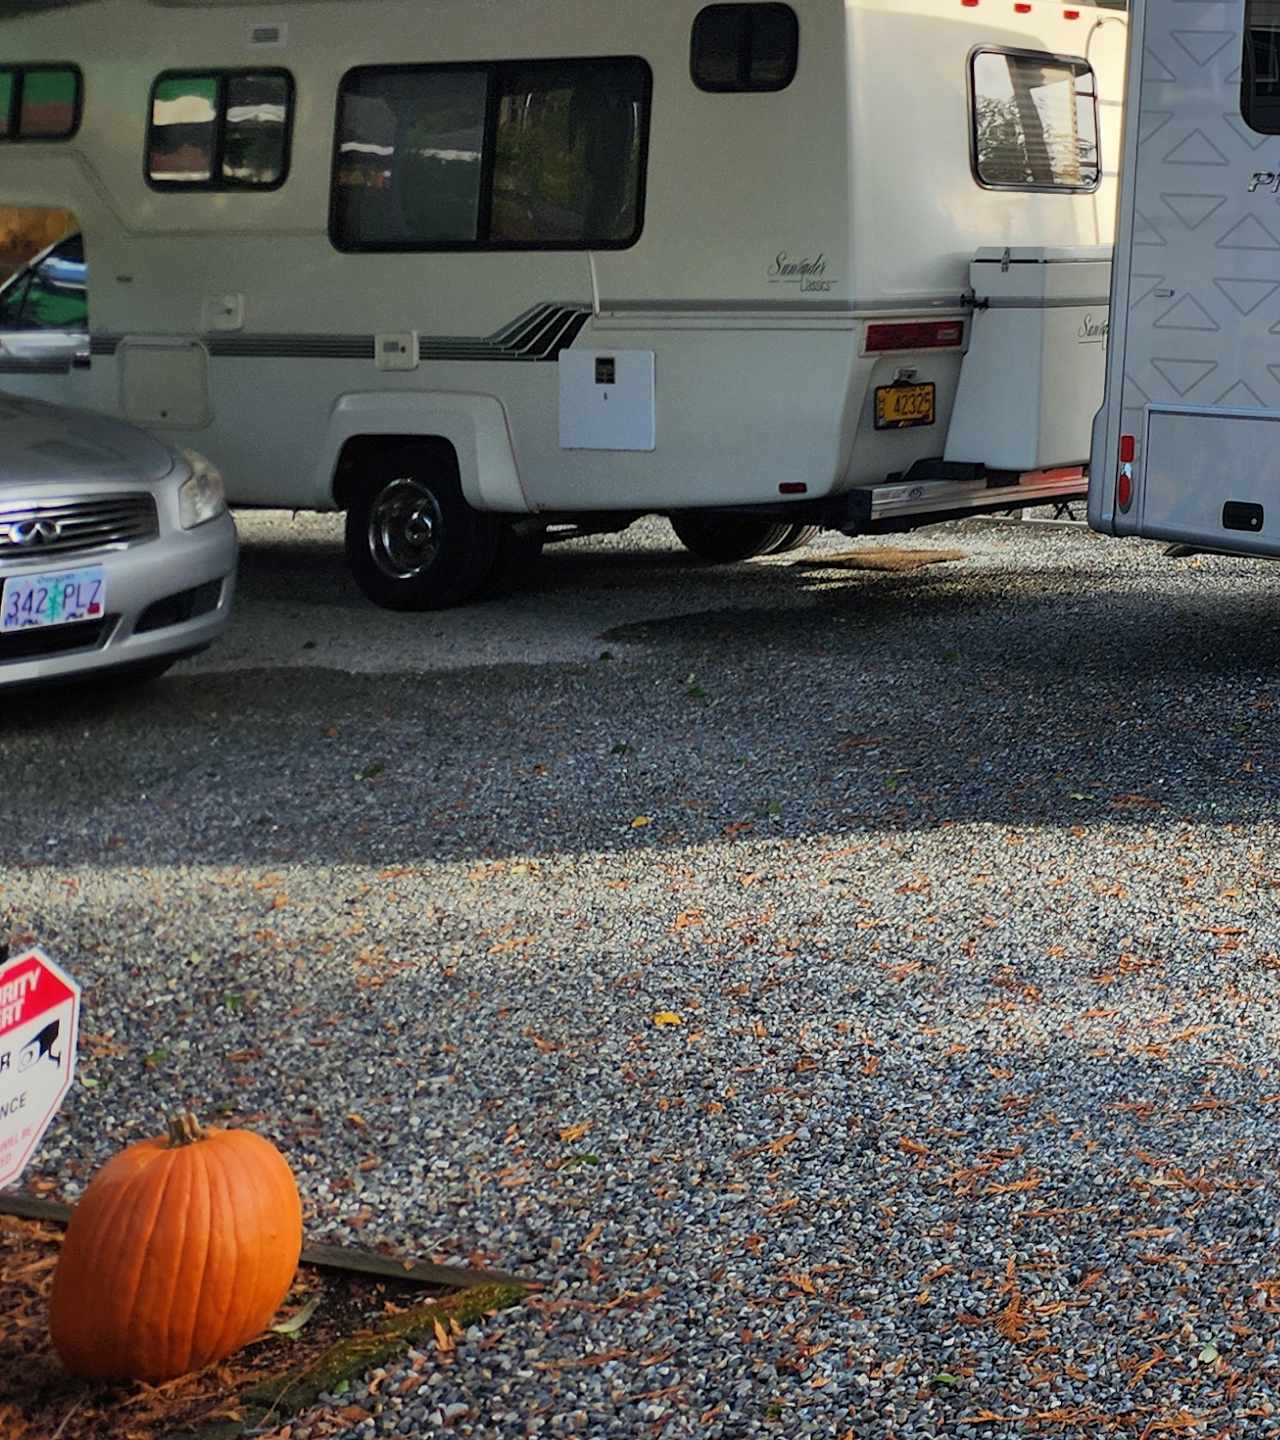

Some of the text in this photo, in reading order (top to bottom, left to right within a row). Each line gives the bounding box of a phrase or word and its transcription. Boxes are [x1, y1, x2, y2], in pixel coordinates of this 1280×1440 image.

[7, 587, 48, 618] 342
[0, 966, 41, 1006] RITY
[0, 998, 25, 1031] RT
